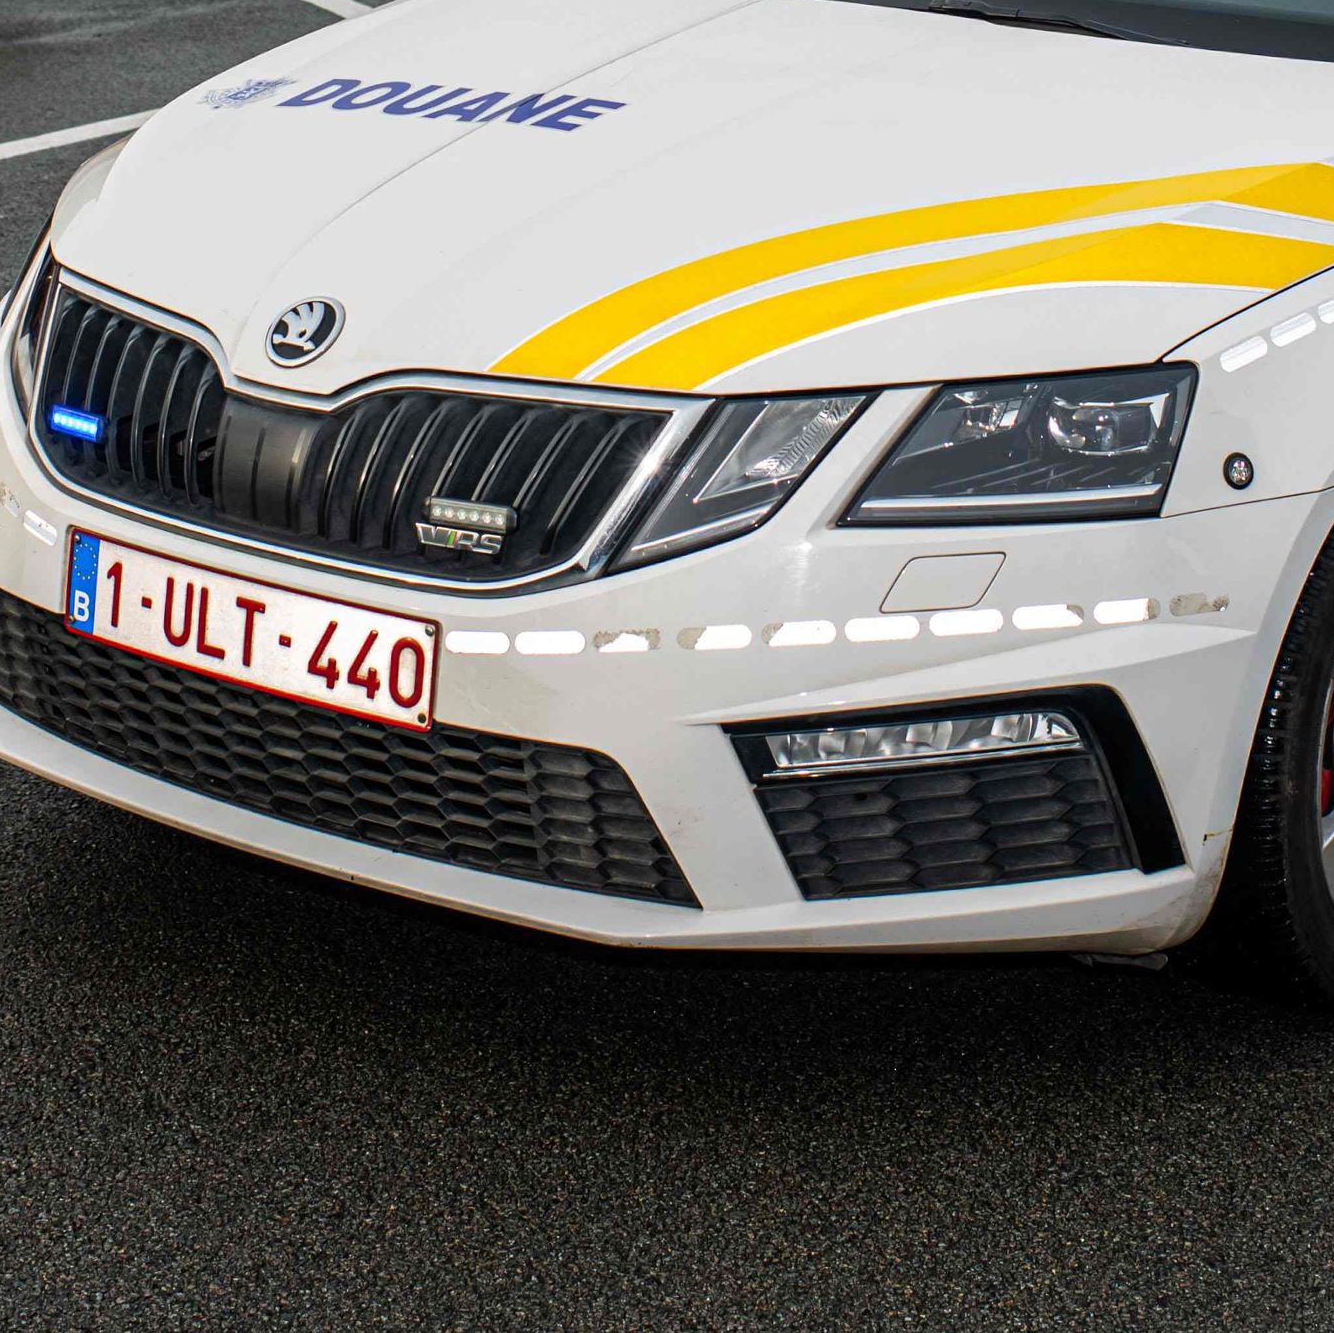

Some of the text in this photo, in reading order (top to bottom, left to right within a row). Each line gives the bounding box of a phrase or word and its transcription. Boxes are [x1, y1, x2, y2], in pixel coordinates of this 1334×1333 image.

[275, 78, 628, 132] DOUANE
[73, 590, 91, 623] B
[107, 561, 426, 708] 1-ULT-440
